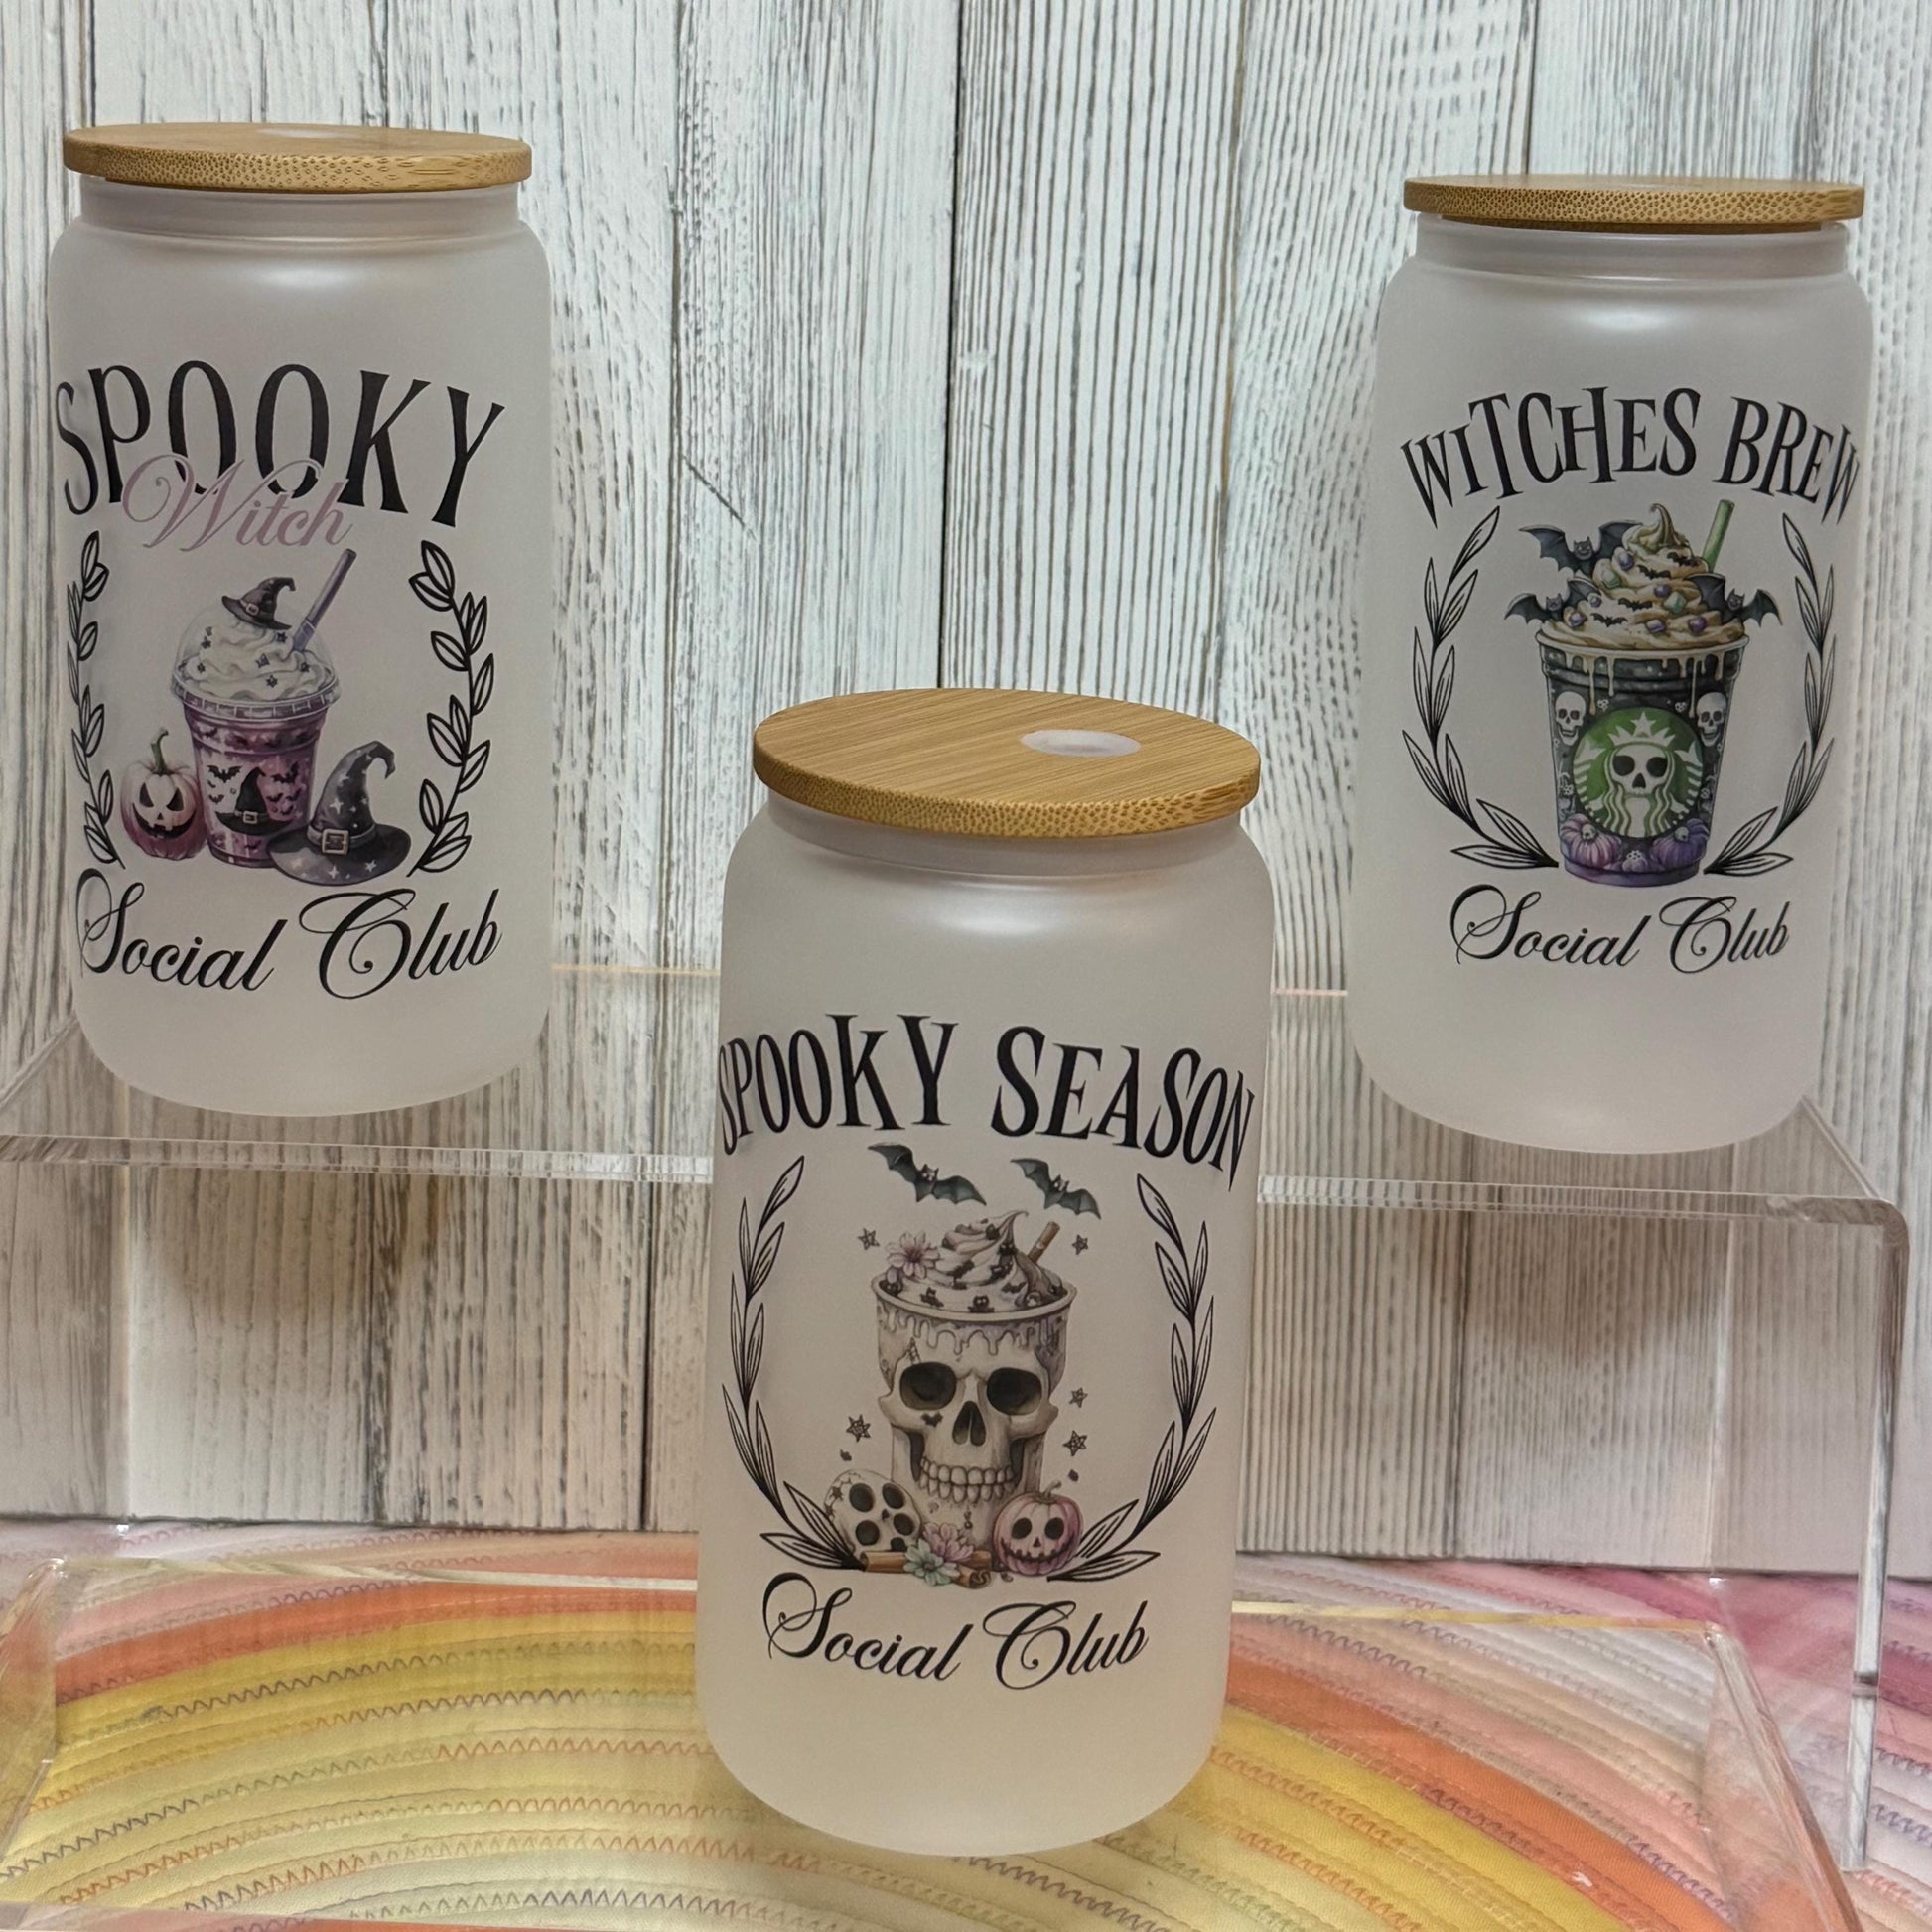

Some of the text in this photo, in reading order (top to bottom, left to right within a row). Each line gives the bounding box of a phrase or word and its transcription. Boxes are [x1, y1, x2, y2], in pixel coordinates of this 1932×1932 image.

[56, 360, 504, 527] SPOOKY
[121, 454, 353, 553] Witch
[1400, 386, 1861, 528] WITCHES BREW
[75, 868, 503, 1000] Social Club
[1449, 884, 1793, 975] Social Club
[719, 1014, 1255, 1192] SPOOKY SEASON
[761, 1572, 1150, 1690] Social Club
